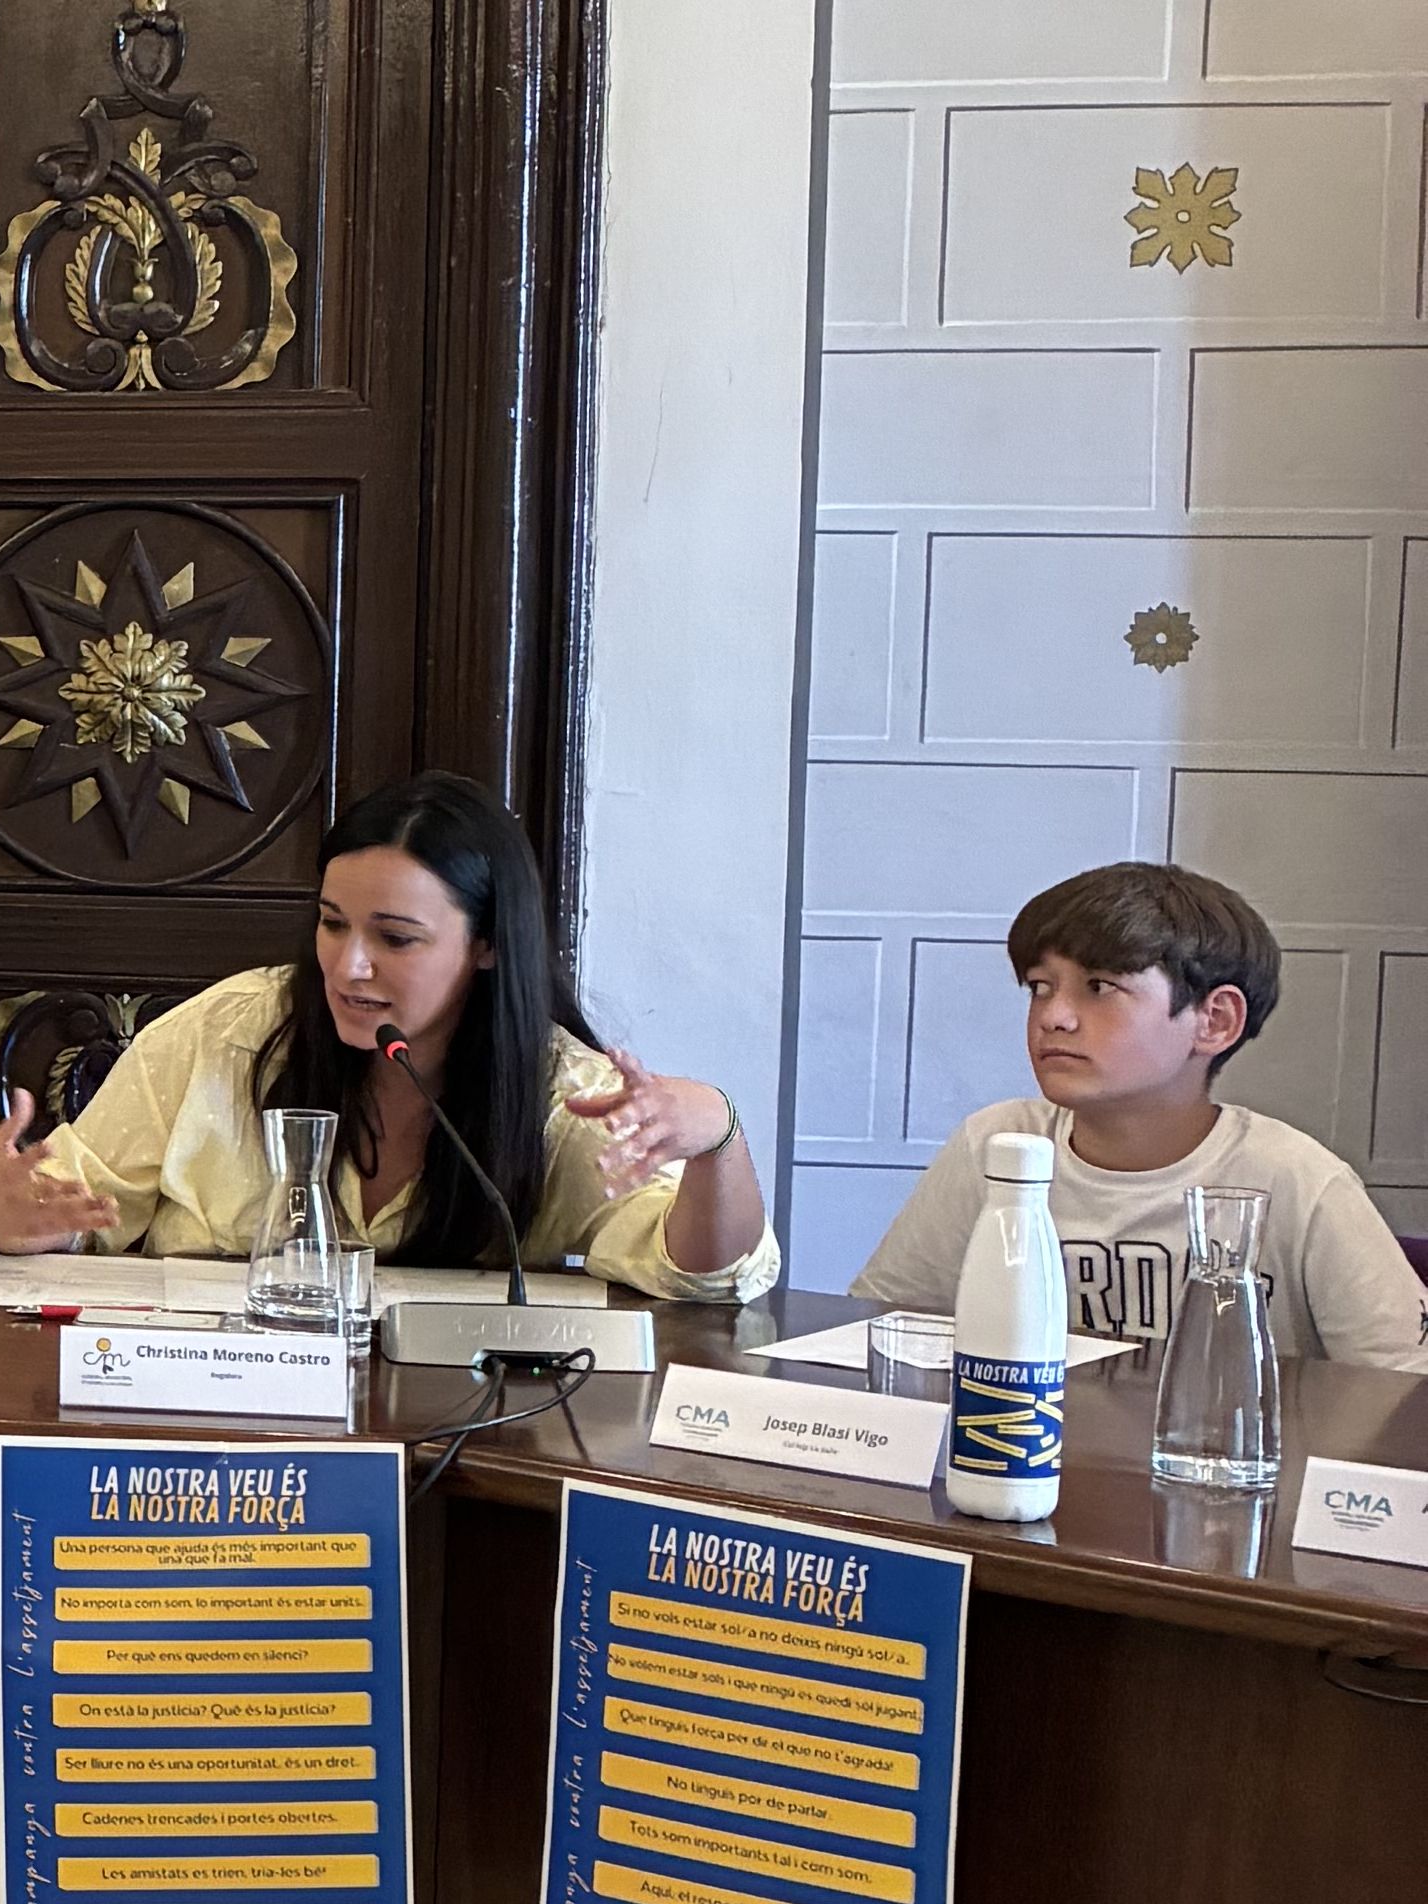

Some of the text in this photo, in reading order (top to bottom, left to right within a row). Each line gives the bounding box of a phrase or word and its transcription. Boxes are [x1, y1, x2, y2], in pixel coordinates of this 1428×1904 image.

[136, 1345, 330, 1365] Christina Moreno Castro
[958, 1360, 970, 1377] LA
[973, 1362, 1029, 1384] NOSTRA
[675, 1404, 730, 1428] CMA
[762, 1415, 807, 1436] Josep
[811, 1422, 850, 1440] Blasi
[855, 1428, 888, 1448] Vigo
[90, 1462, 307, 1496] LA NOSTRA VEU ÉS
[91, 1495, 305, 1532] LA NOSTRA FORÇA
[1324, 1490, 1393, 1516] CMA
[648, 1523, 869, 1591] LA NOSTRA VEU ÉS
[647, 1554, 863, 1626] LA NOSTRA FORÇA
